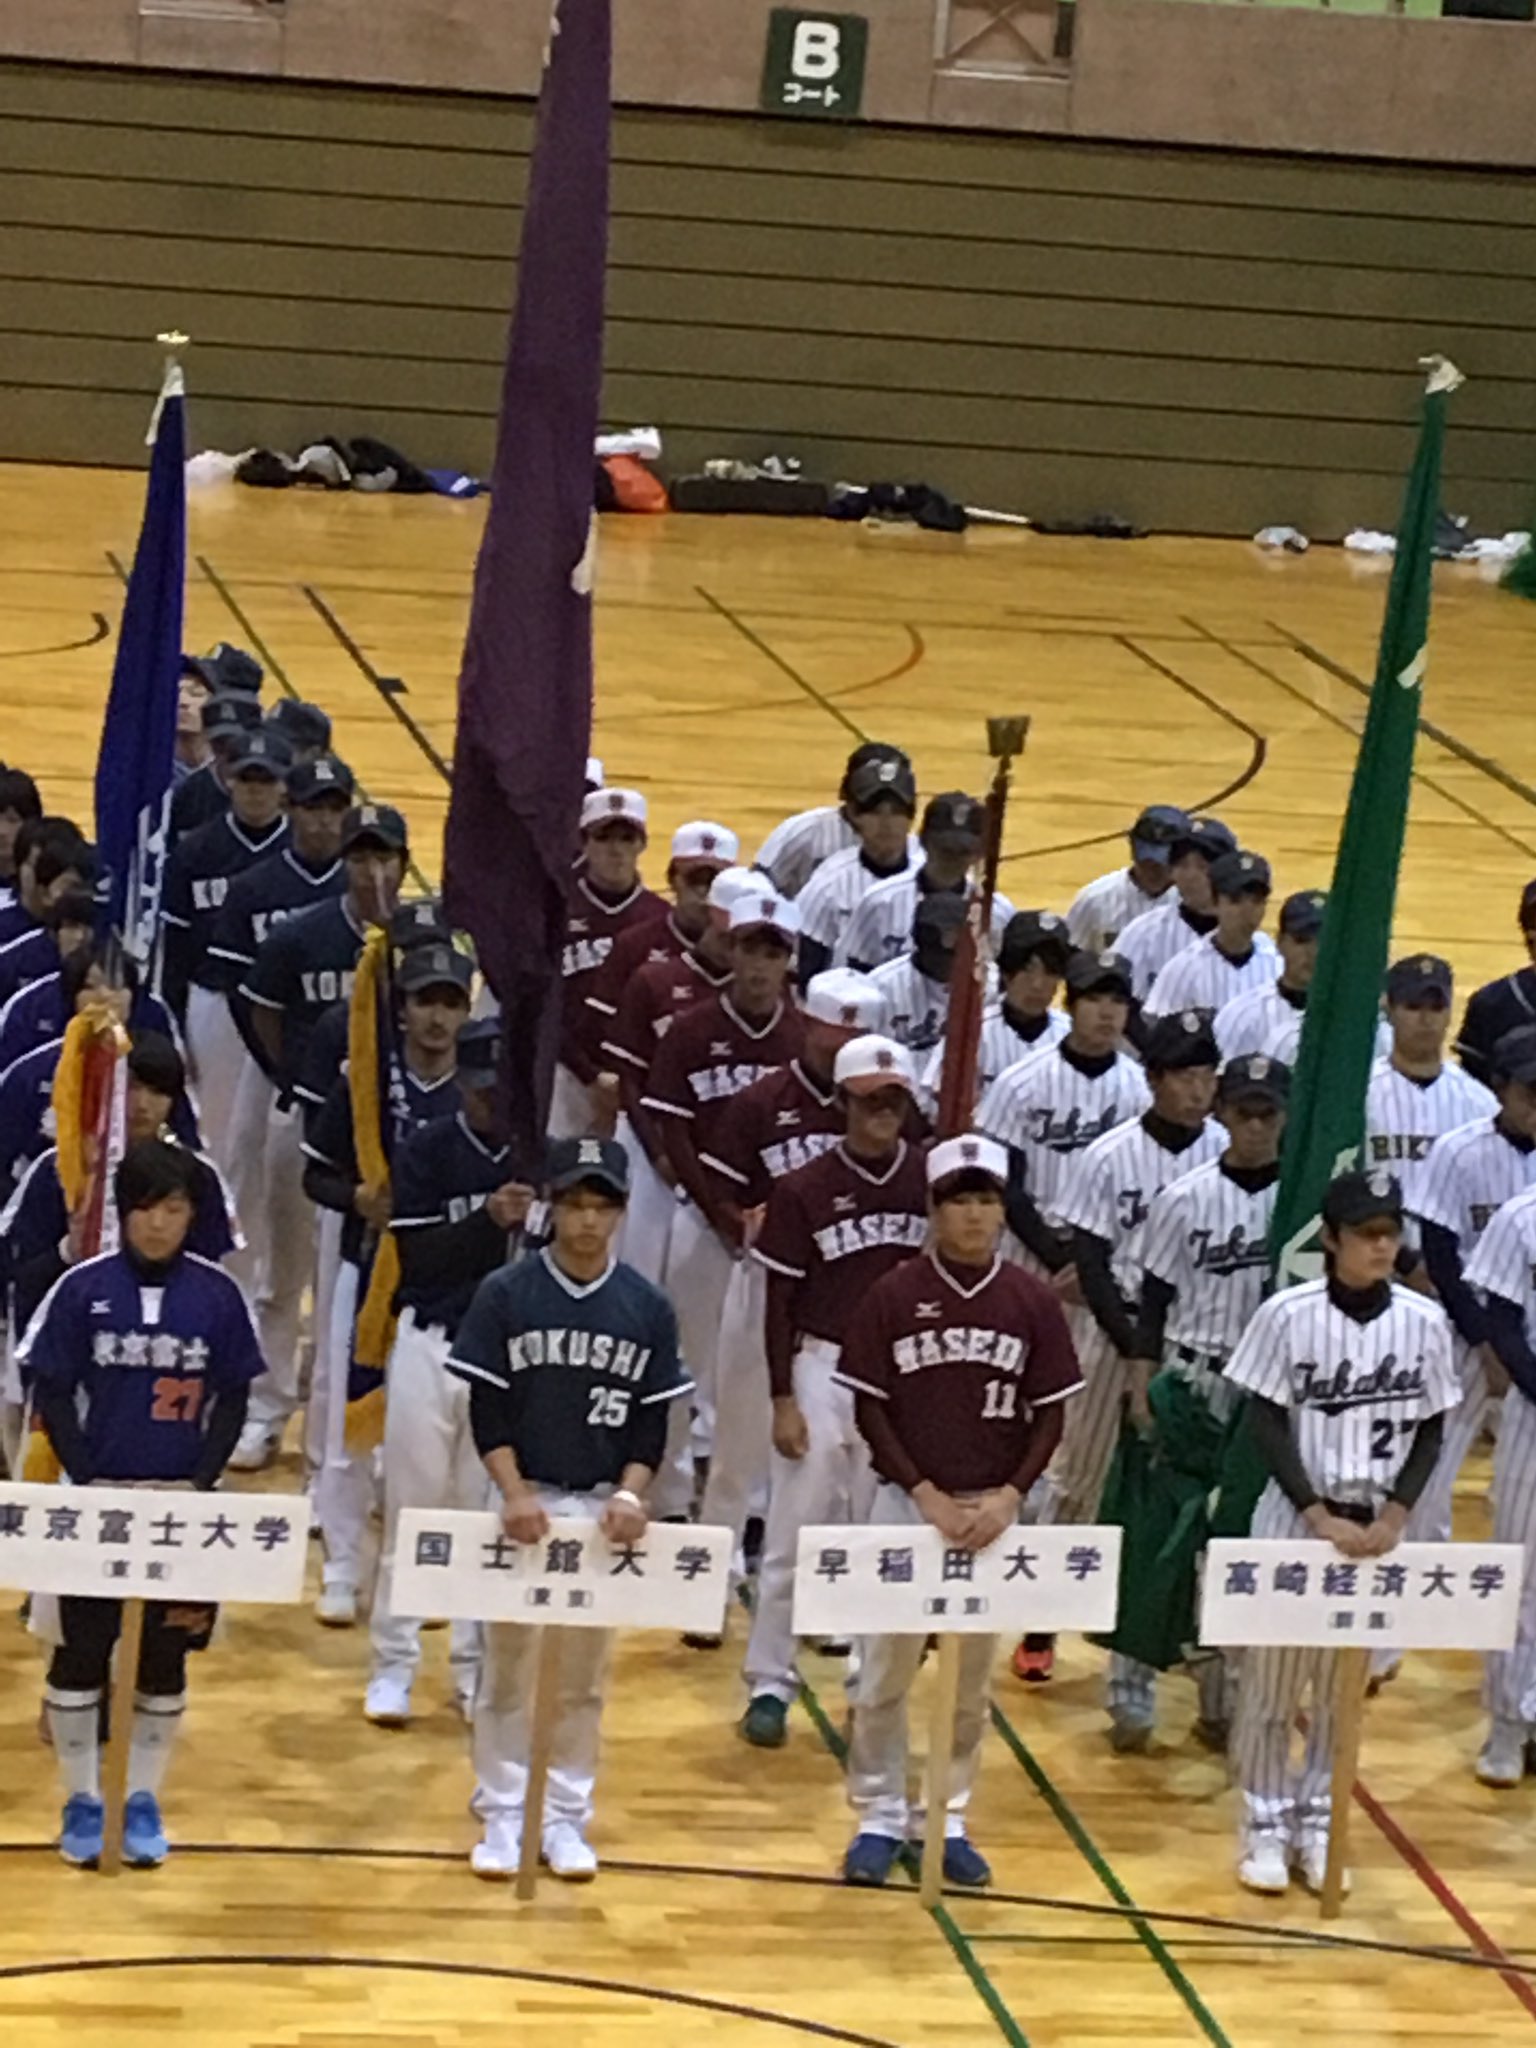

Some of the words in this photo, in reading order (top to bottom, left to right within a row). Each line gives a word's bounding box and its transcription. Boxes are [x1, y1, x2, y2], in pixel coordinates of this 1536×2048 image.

[792, 20, 840, 79] B
[783, 82, 841, 107] コート
[507, 1328, 651, 1382] KOKUSHI
[151, 1376, 204, 1421] 27
[587, 1386, 632, 1428] 25
[981, 1379, 1017, 1418] 11
[0, 1503, 291, 1551] 東京富士大学
[815, 1546, 1101, 1582] 早稲田大学
